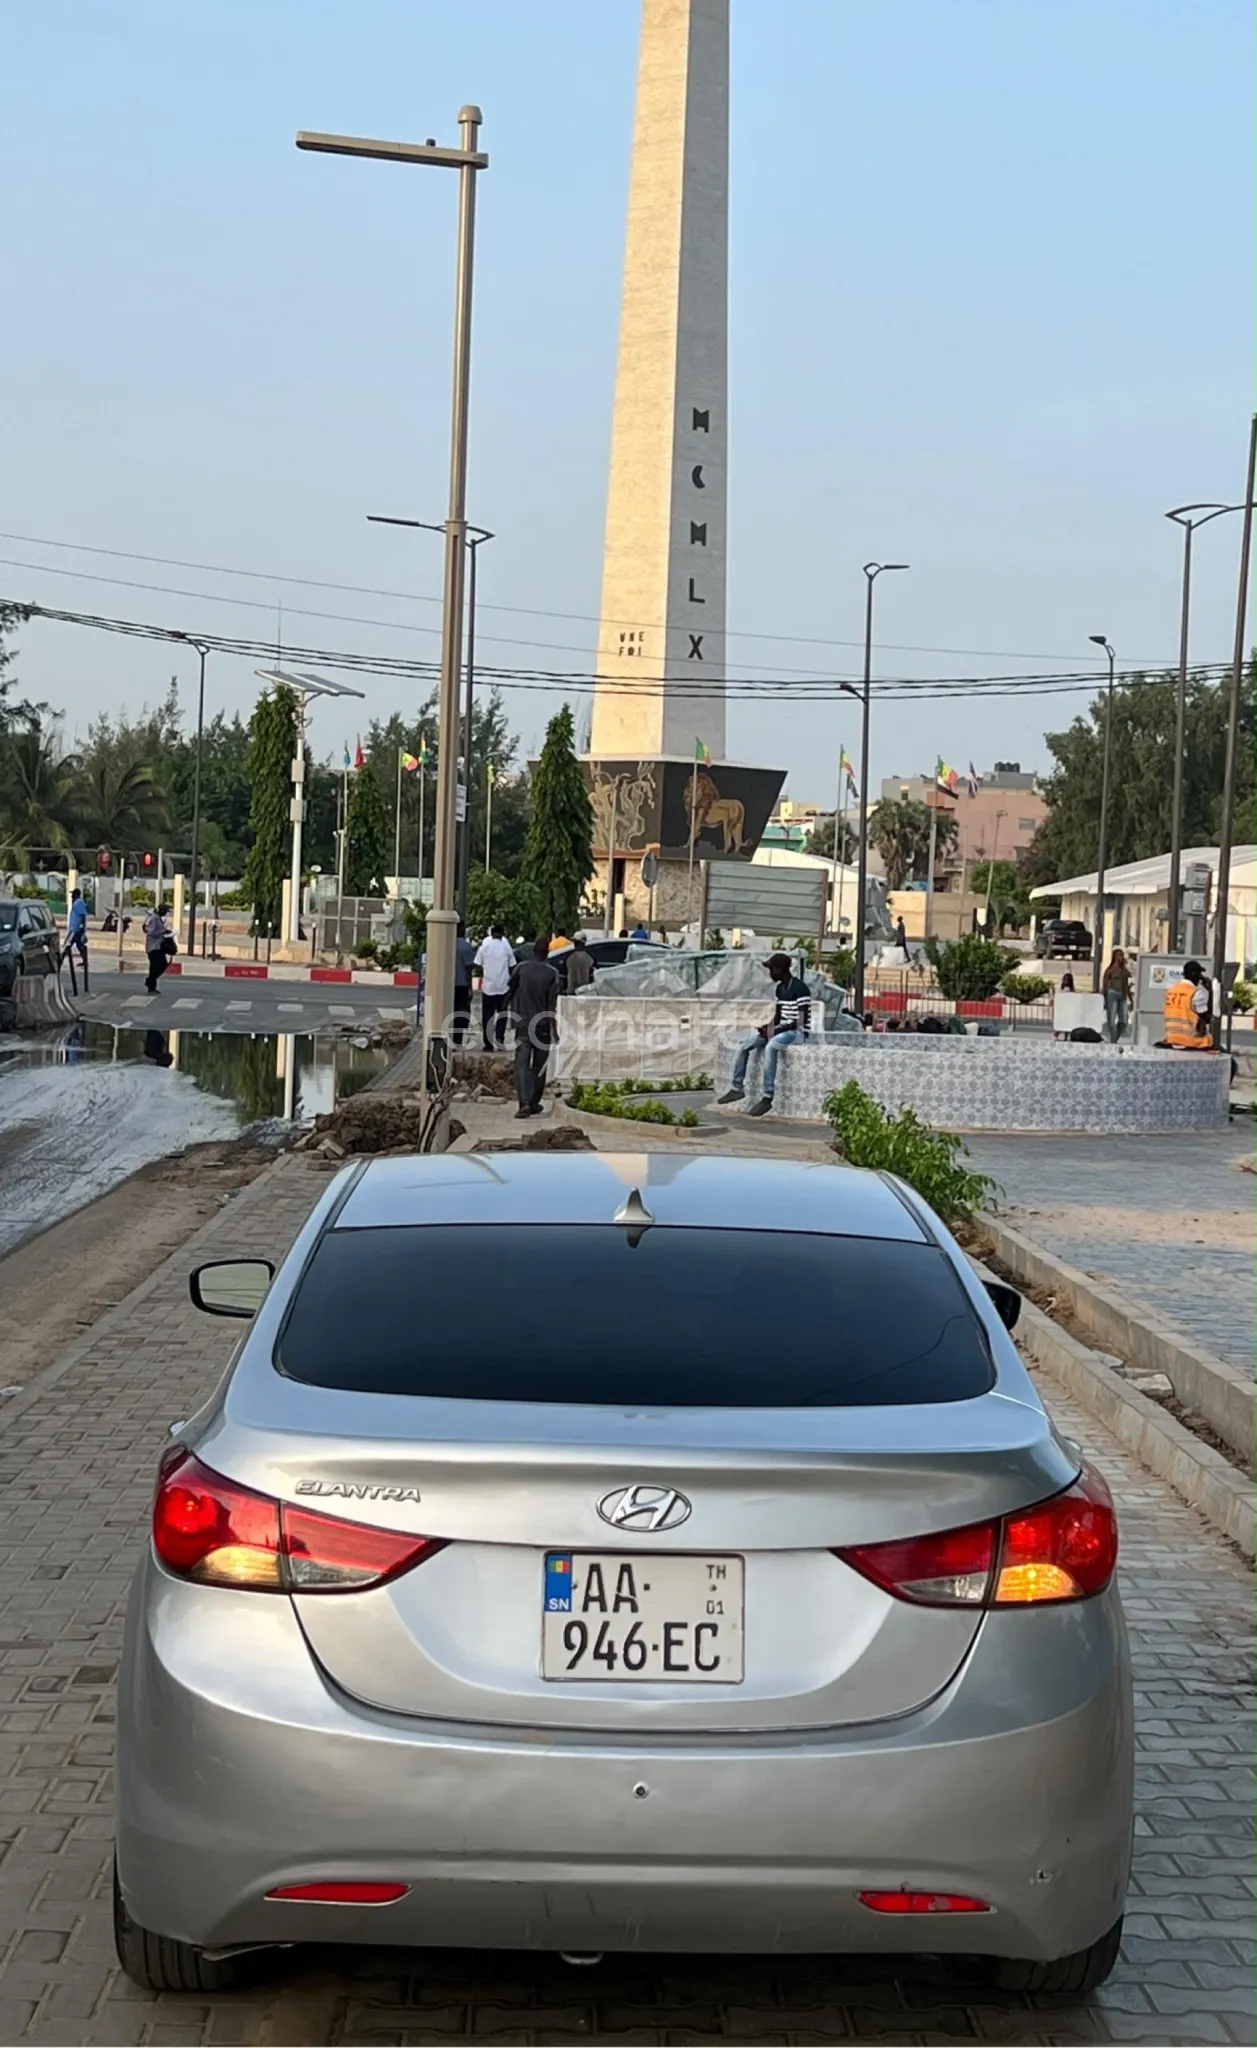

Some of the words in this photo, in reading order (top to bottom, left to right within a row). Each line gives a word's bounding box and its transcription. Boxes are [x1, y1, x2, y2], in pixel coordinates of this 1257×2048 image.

[295, 1480, 421, 1503] ELANTRA
[705, 1564, 727, 1580] TH
[549, 1598, 570, 1610] SN
[706, 1600, 724, 1615] 01
